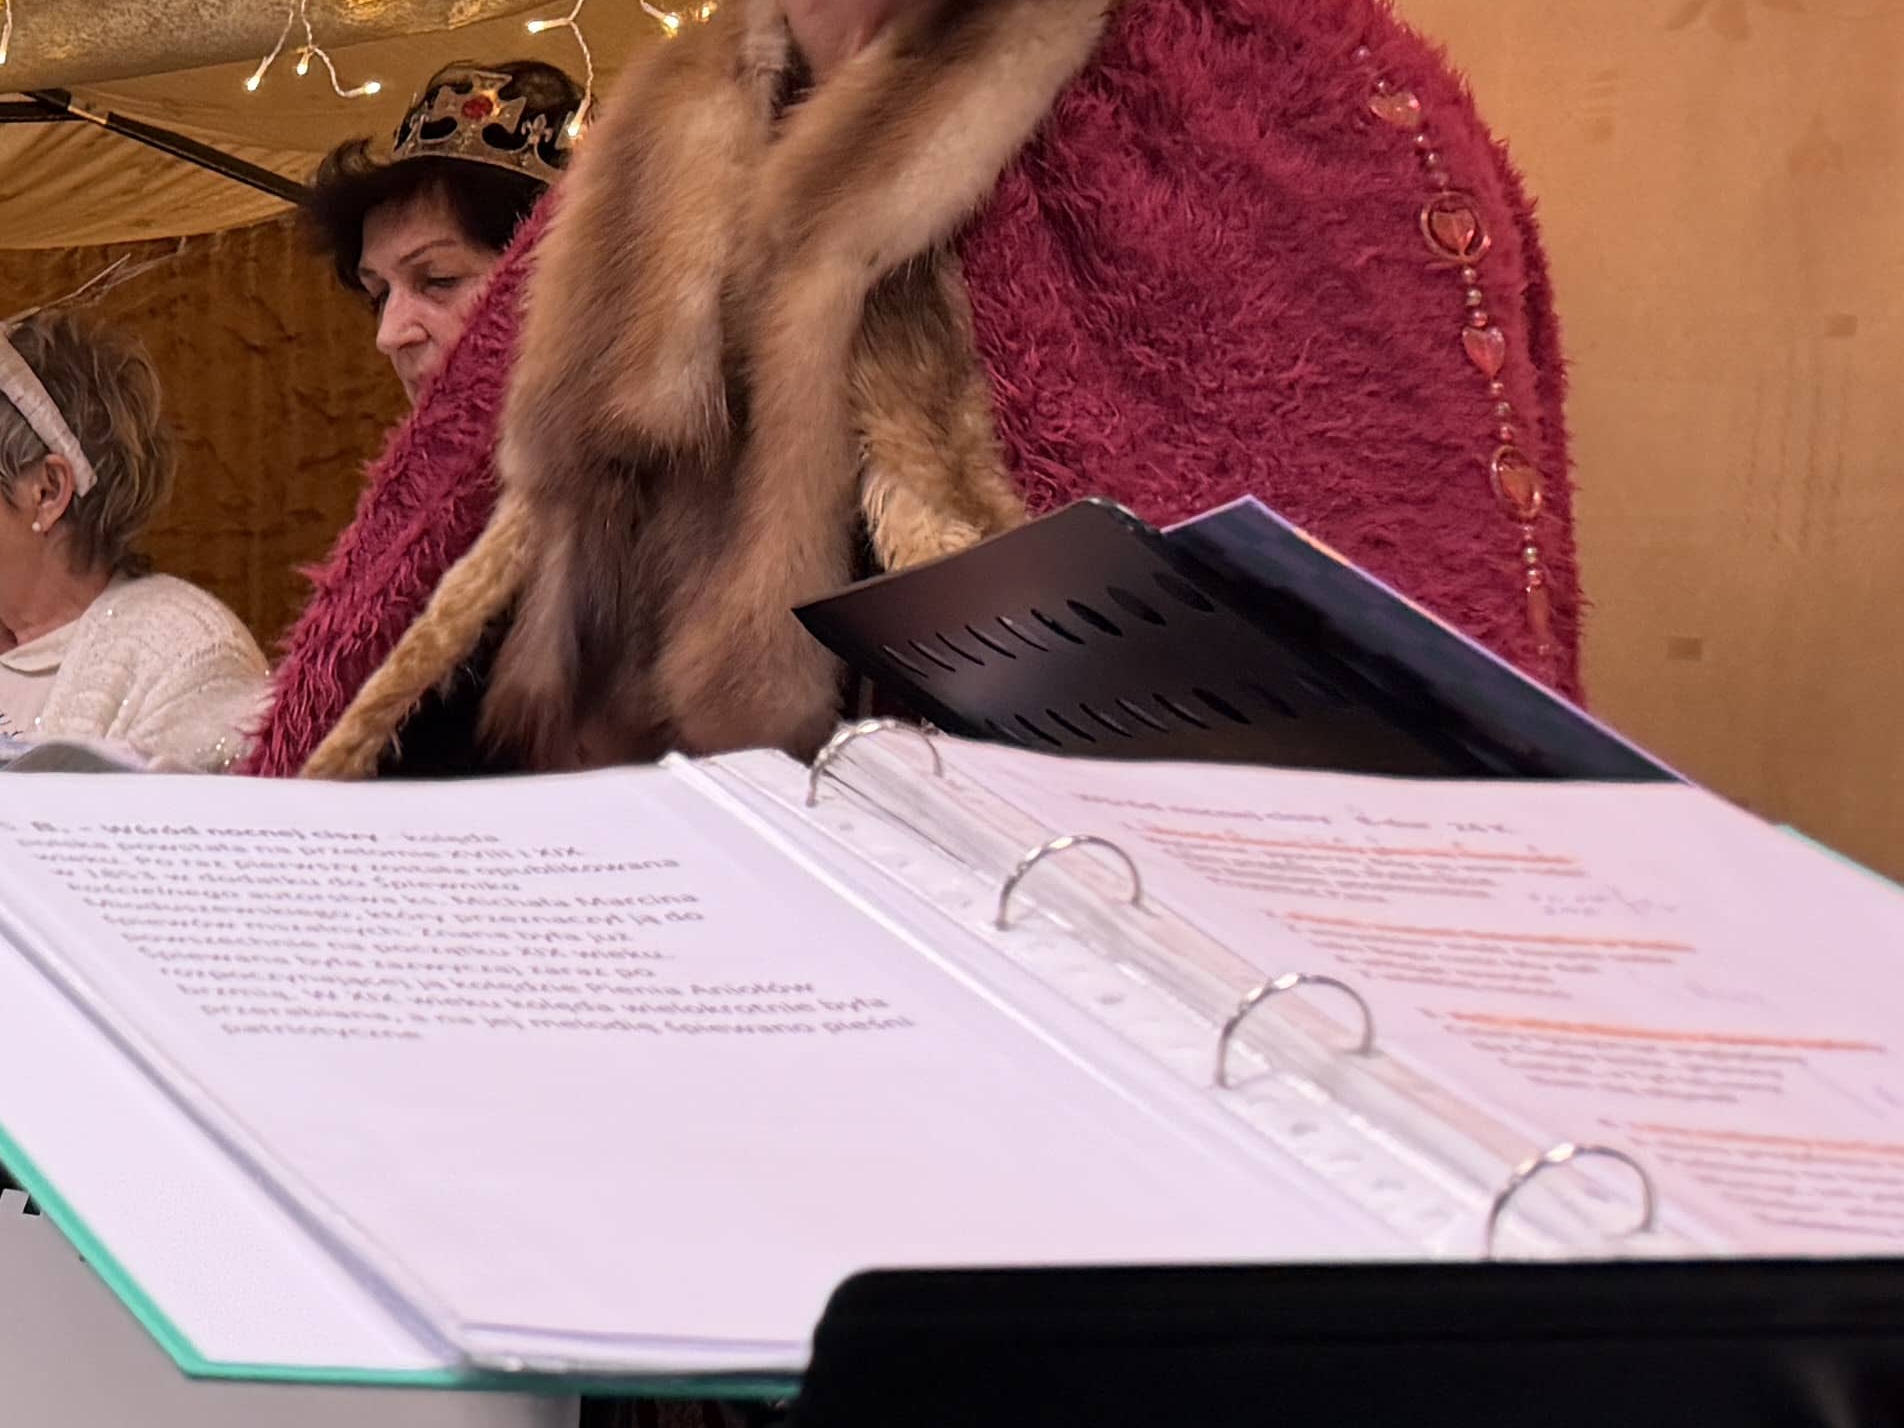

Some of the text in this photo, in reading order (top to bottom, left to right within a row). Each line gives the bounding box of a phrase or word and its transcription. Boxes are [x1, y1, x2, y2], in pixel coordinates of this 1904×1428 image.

[100, 822, 200, 835] Wśród
[205, 827, 306, 842] nocnej
[311, 829, 378, 844] ciszy
[254, 845, 291, 854] na
[533, 845, 585, 858] XIX
[180, 858, 225, 868] raz
[234, 860, 360, 874] pierwszy
[370, 863, 471, 875] została
[475, 859, 681, 876] opublikowana
[164, 872, 190, 882] w
[197, 872, 321, 887] dodatku
[327, 875, 366, 888] do
[371, 875, 522, 891] Śpiewnika
[65, 882, 240, 900] kościelnego
[248, 890, 398, 905] autorstwa
[450, 895, 571, 909] Michała
[575, 893, 700, 908] Marcina
[364, 908, 445, 925] który
[452, 913, 624, 927] przeznaczył
[664, 909, 706, 923] do
[421, 926, 510, 941] Znana
[513, 929, 583, 944] była
[585, 930, 633, 944] już
[326, 941, 365, 952] na
[371, 943, 512, 958] początku
[514, 944, 568, 958] XIX
[294, 953, 366, 970] była
[373, 959, 524, 978] zazwyczaj
[530, 965, 610, 979] zaraz
[614, 967, 658, 981] po
[449, 977, 582, 995] kolędzie
[689, 981, 815, 996] Aniołów
[343, 988, 397, 1005] XIX
[406, 994, 504, 1010] wieku
[503, 997, 614, 1015] kolęda
[620, 1000, 817, 1016] wielokrotnie
[816, 996, 891, 1014] była
[434, 1013, 476, 1026] na
[478, 1012, 527, 1031] jej
[529, 1018, 663, 1035] melodię
[664, 1019, 817, 1036] śpiewano
[821, 1014, 919, 1035] pieśni
